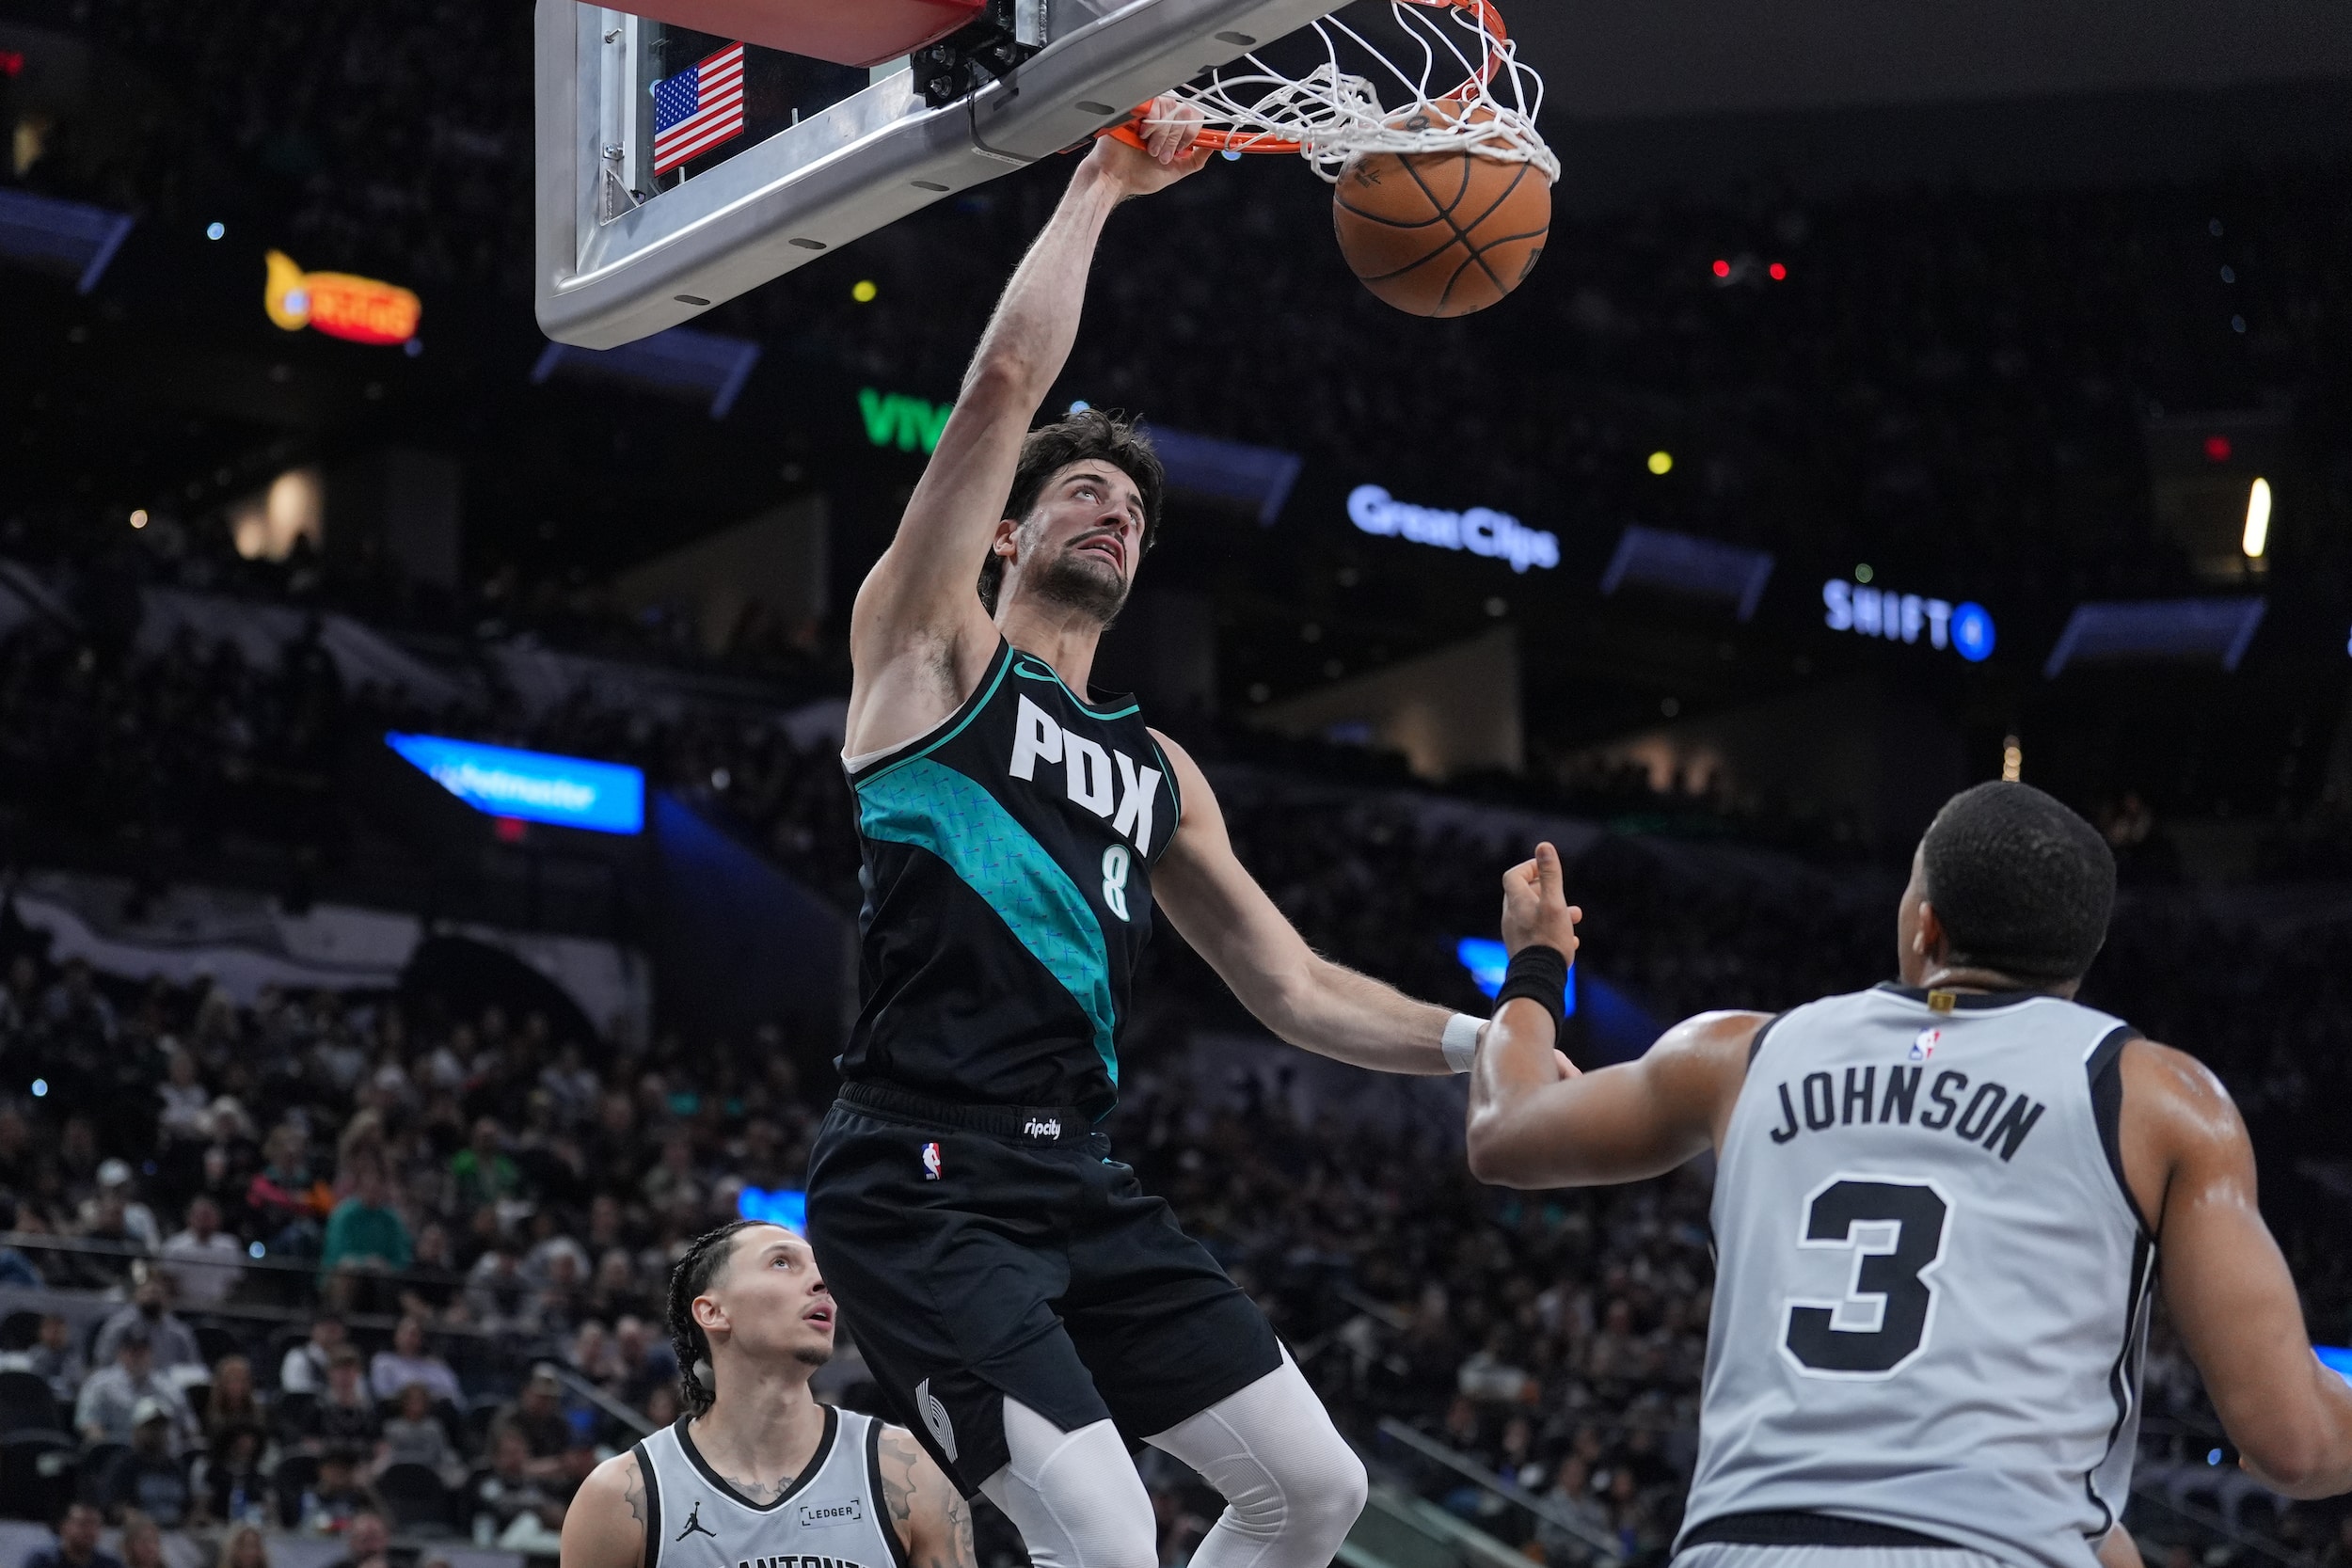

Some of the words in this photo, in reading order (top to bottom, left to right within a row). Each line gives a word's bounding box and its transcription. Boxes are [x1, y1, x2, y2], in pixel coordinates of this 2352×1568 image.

[1009, 692, 1163, 859] PDX
[1102, 844, 1131, 923] 8
[1024, 1117, 1061, 1140] ripcity
[1770, 1065, 2046, 1164] JOHNSON
[1776, 1172, 1956, 1381] 3
[808, 1507, 852, 1520] LEDGER
